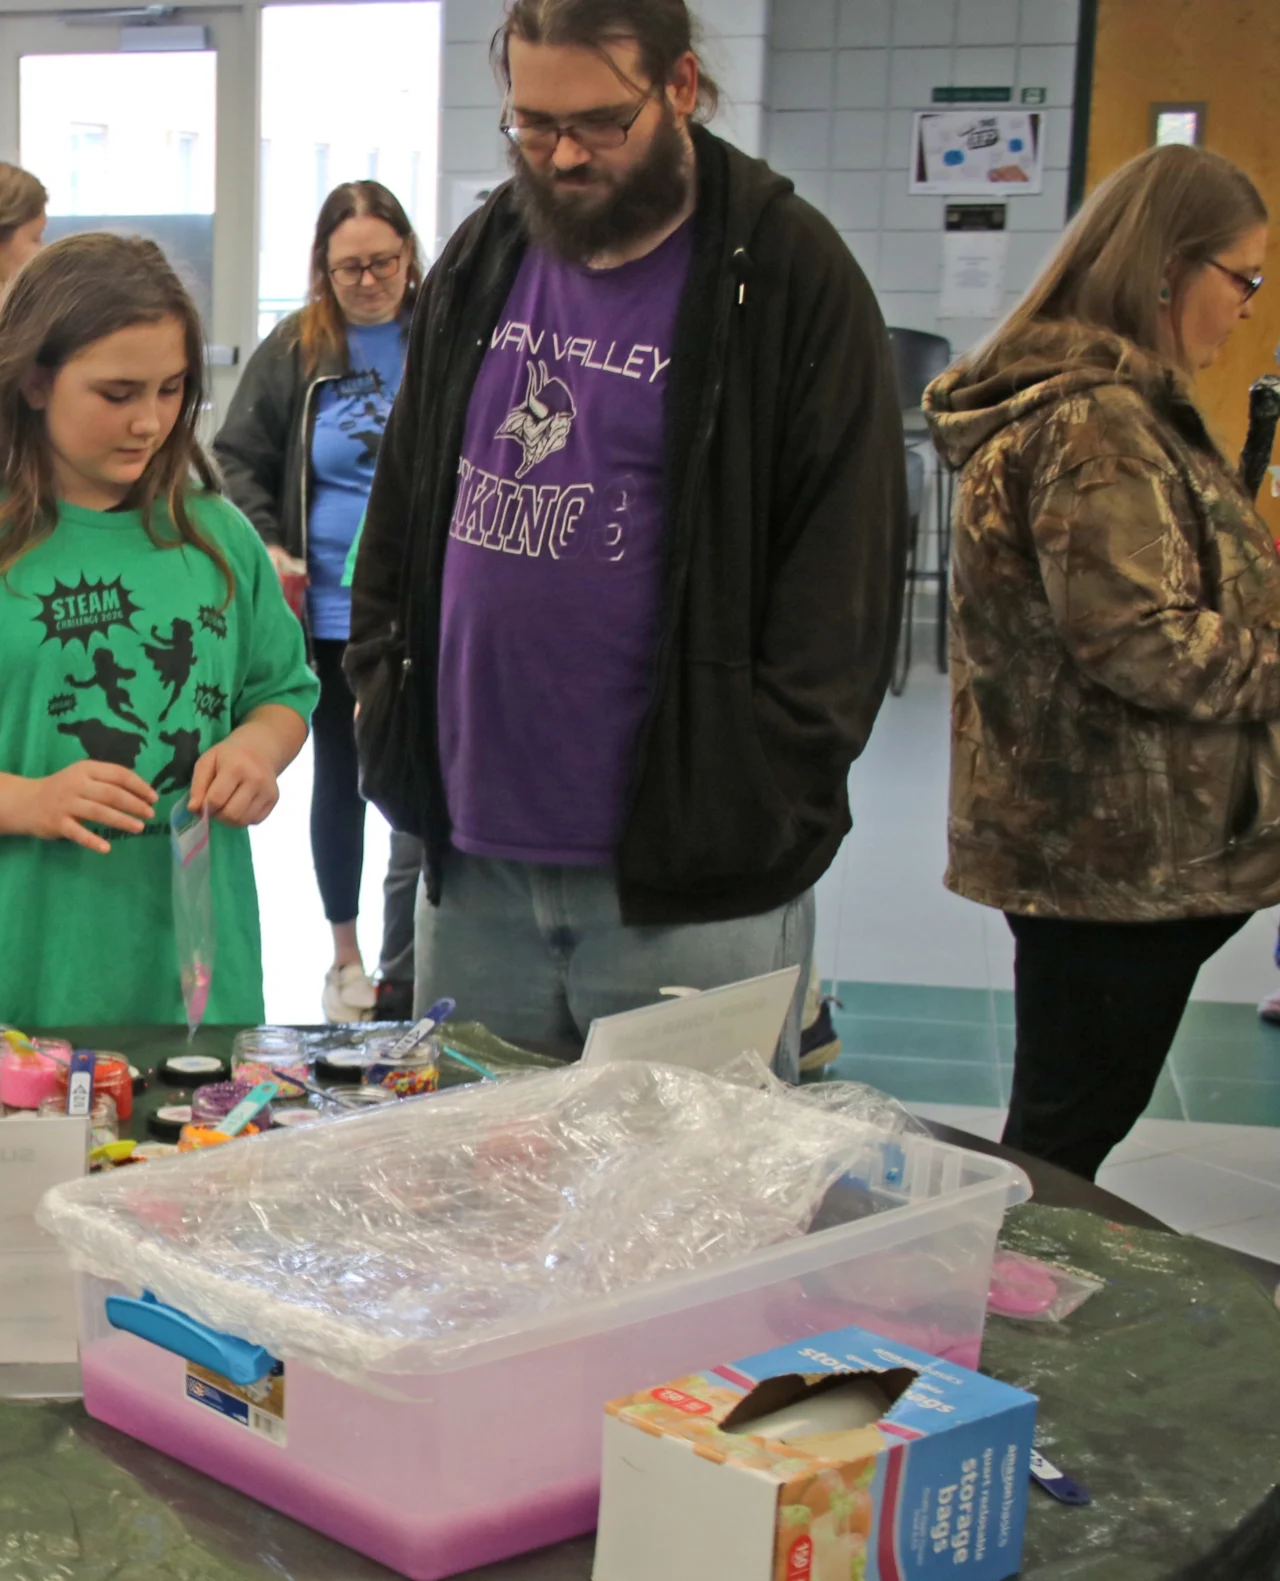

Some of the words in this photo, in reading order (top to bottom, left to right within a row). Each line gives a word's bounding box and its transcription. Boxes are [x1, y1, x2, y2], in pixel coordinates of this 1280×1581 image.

[553, 333, 671, 383] VALLEY
[51, 587, 120, 620] STEAM
[56, 614, 99, 631] CHALLENGE
[797, 1347, 857, 1374] stor
[982, 1447, 994, 1487] quart
[930, 1483, 958, 1554] bags
[951, 1457, 978, 1566] storage
[975, 1489, 990, 1561] reclosable
